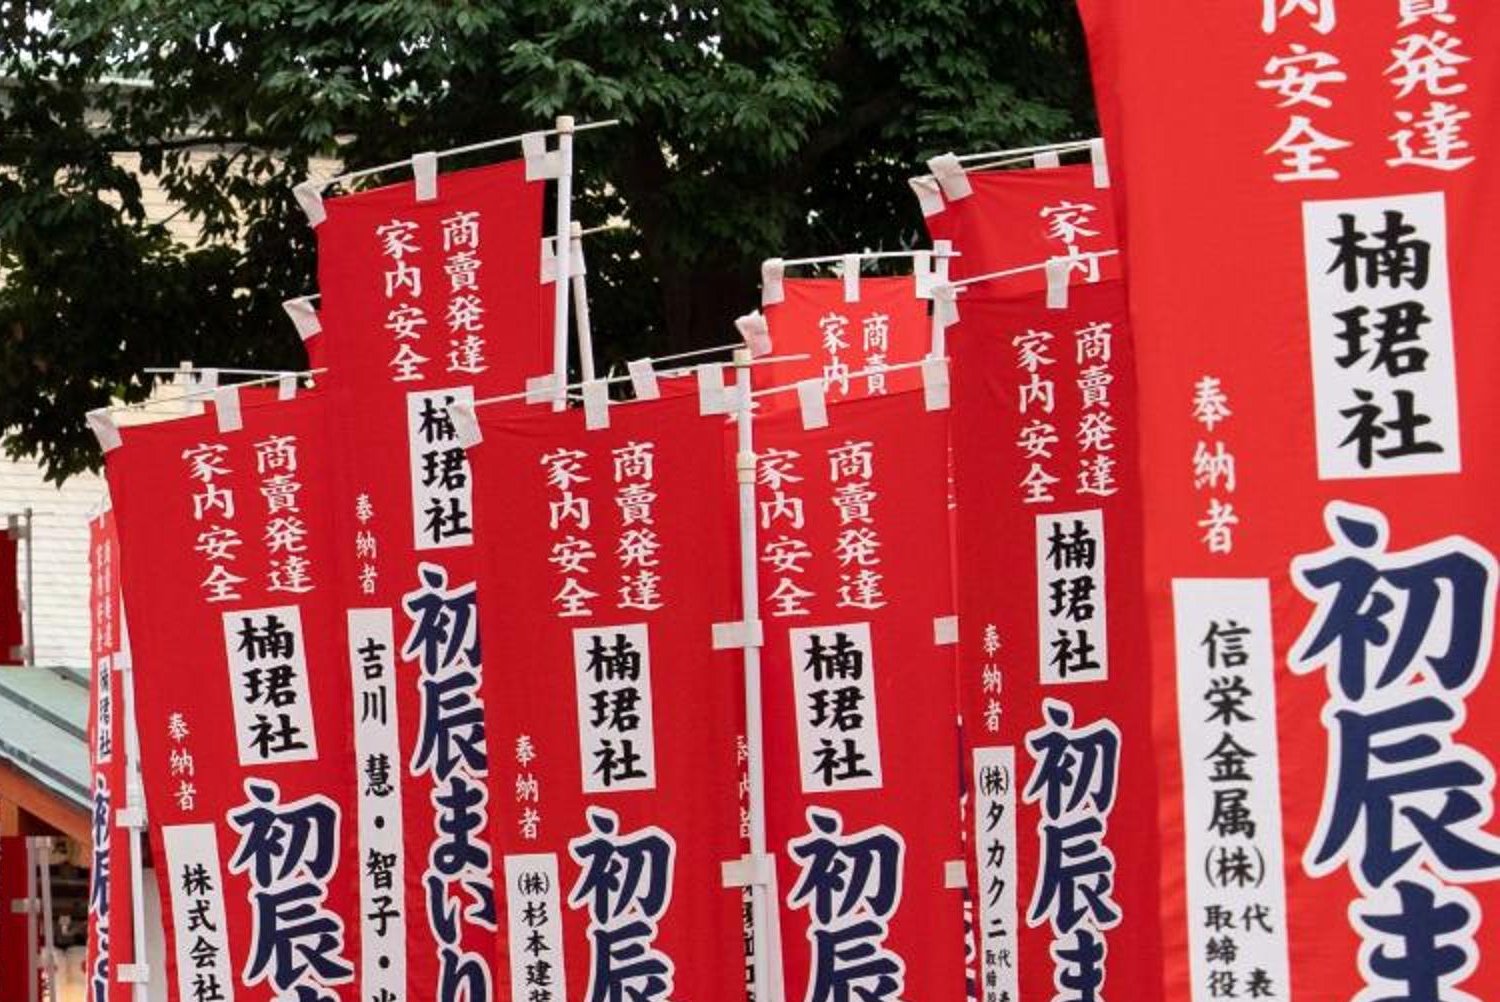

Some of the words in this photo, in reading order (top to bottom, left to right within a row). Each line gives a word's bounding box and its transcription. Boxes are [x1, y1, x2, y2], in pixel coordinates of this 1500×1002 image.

[375, 218, 429, 382] 家内安全
[440, 210, 490, 375] 商賣発達
[1324, 209, 1446, 469] 楠珺社
[417, 395, 474, 544] 楠珺社
[1011, 328, 1061, 504] 家内安全
[1075, 321, 1120, 498] 商賣発達
[1191, 375, 1241, 555] 奉納者
[181, 442, 248, 603] 家内安全
[252, 434, 316, 595] 商賣発達
[354, 492, 380, 595] 奉納者
[539, 446, 598, 619] 家内安全
[610, 440, 665, 611] 商賣発達
[754, 447, 816, 618] 家内安全
[826, 440, 889, 611] 商賣発達
[981, 624, 1003, 733] 奉納者
[1046, 519, 1102, 678] 楠珺社
[167, 711, 198, 813] 奉納者
[237, 616, 309, 760] 楠珺社
[584, 634, 648, 788] 楠珺社
[801, 633, 876, 788] 楠珺社
[1199, 620, 1267, 889] 信栄金属(株)
[514, 734, 541, 840] 奉納者
[1240, 903, 1276, 1000] 代表
